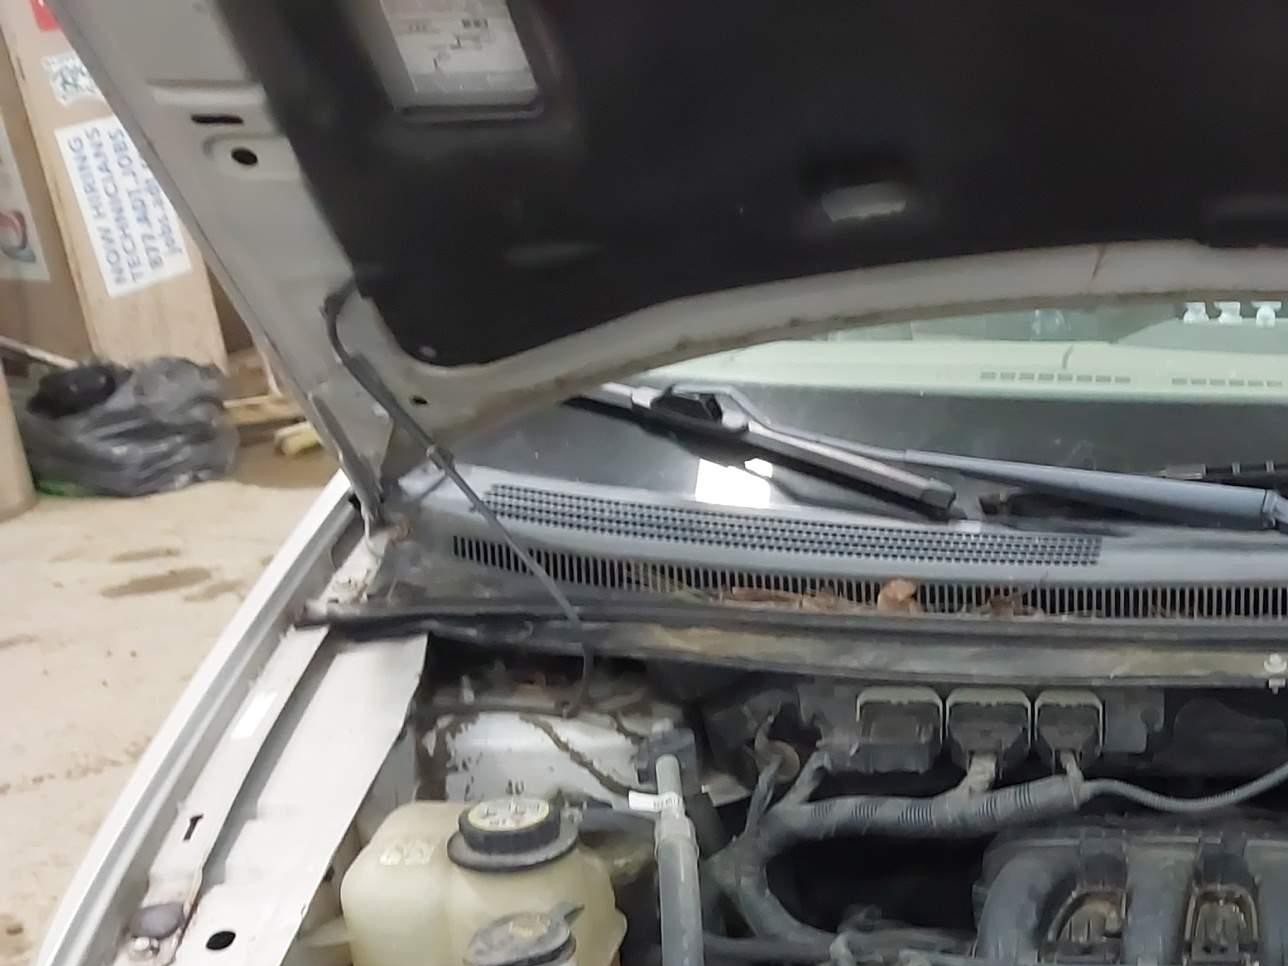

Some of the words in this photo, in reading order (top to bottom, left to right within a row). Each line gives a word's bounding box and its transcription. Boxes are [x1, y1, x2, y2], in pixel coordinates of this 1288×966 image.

[68, 136, 105, 219] HIRING
[85, 127, 144, 282] TECHNICIANS
[96, 226, 126, 284] NOW
